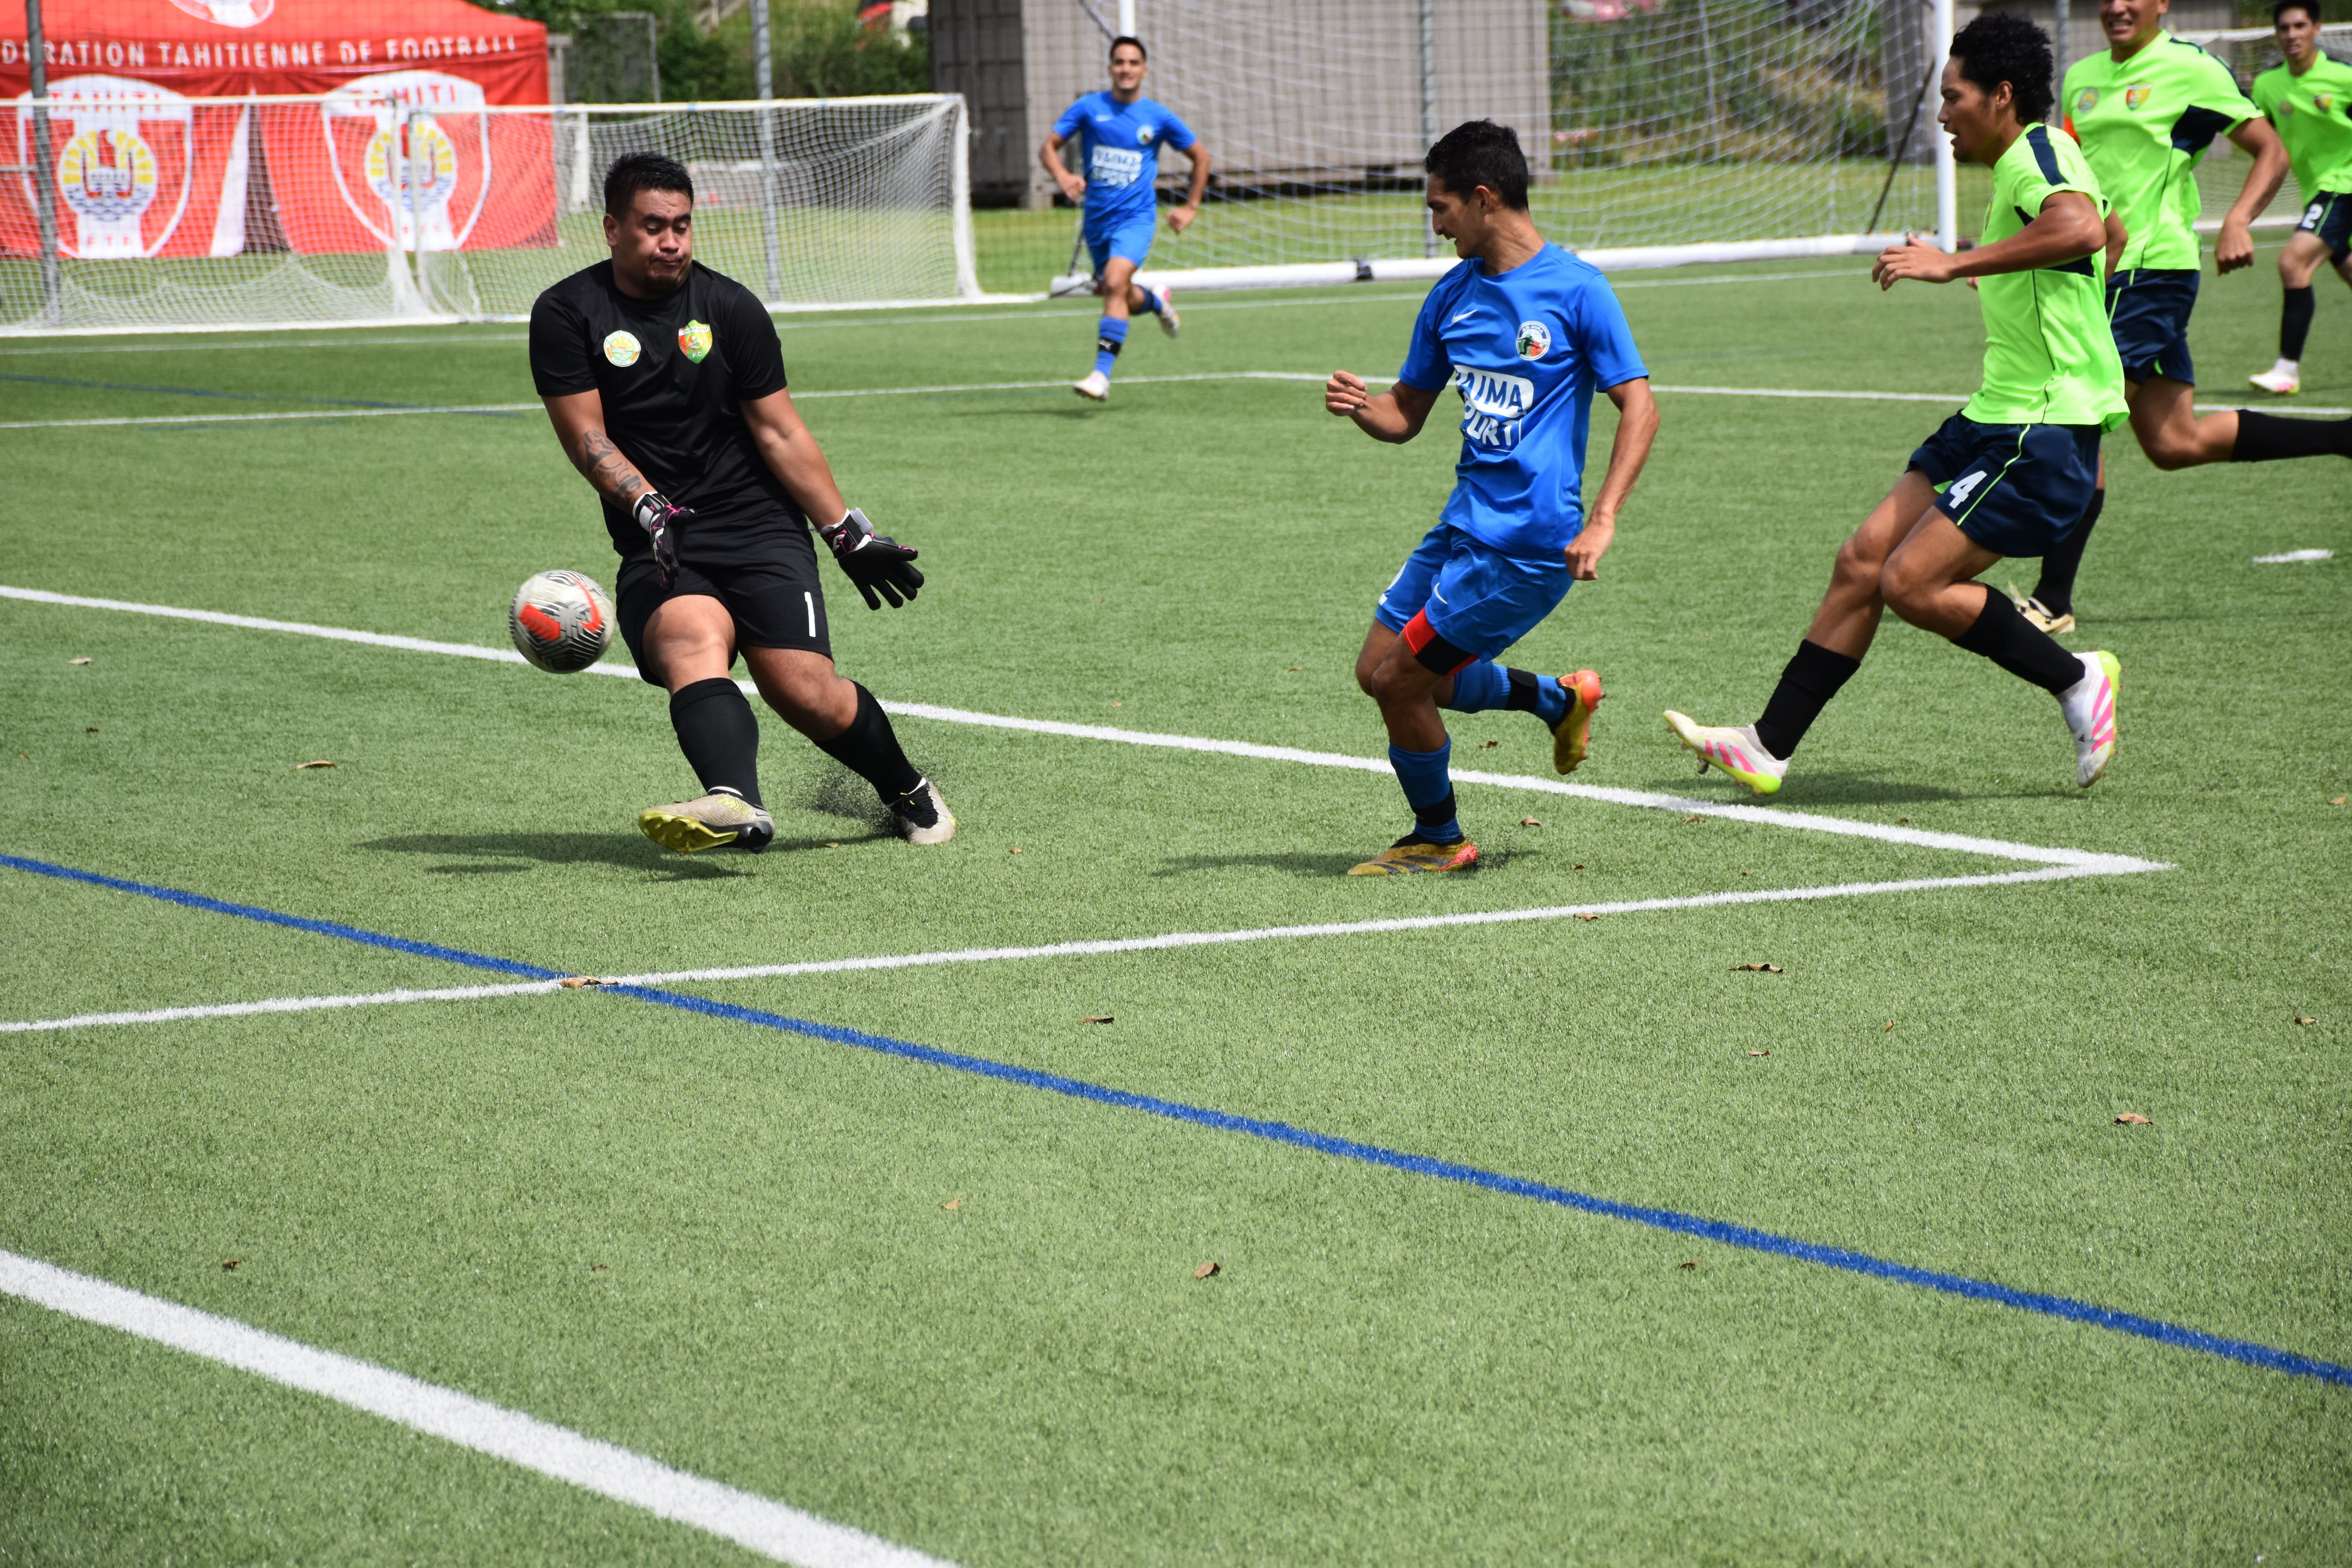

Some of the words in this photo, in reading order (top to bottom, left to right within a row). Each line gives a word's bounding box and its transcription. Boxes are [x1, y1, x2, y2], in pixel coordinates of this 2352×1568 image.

[158, 41, 325, 67] TAHITIENNE
[339, 40, 372, 64] DE
[385, 34, 516, 61] FOOTBALL
[48, 91, 162, 113] TAHITI
[348, 84, 456, 109] TAHITI
[2302, 203, 2324, 229] 2
[1463, 392, 1519, 446] PORT
[1949, 470, 1988, 509] 4
[804, 591, 816, 637] 1
